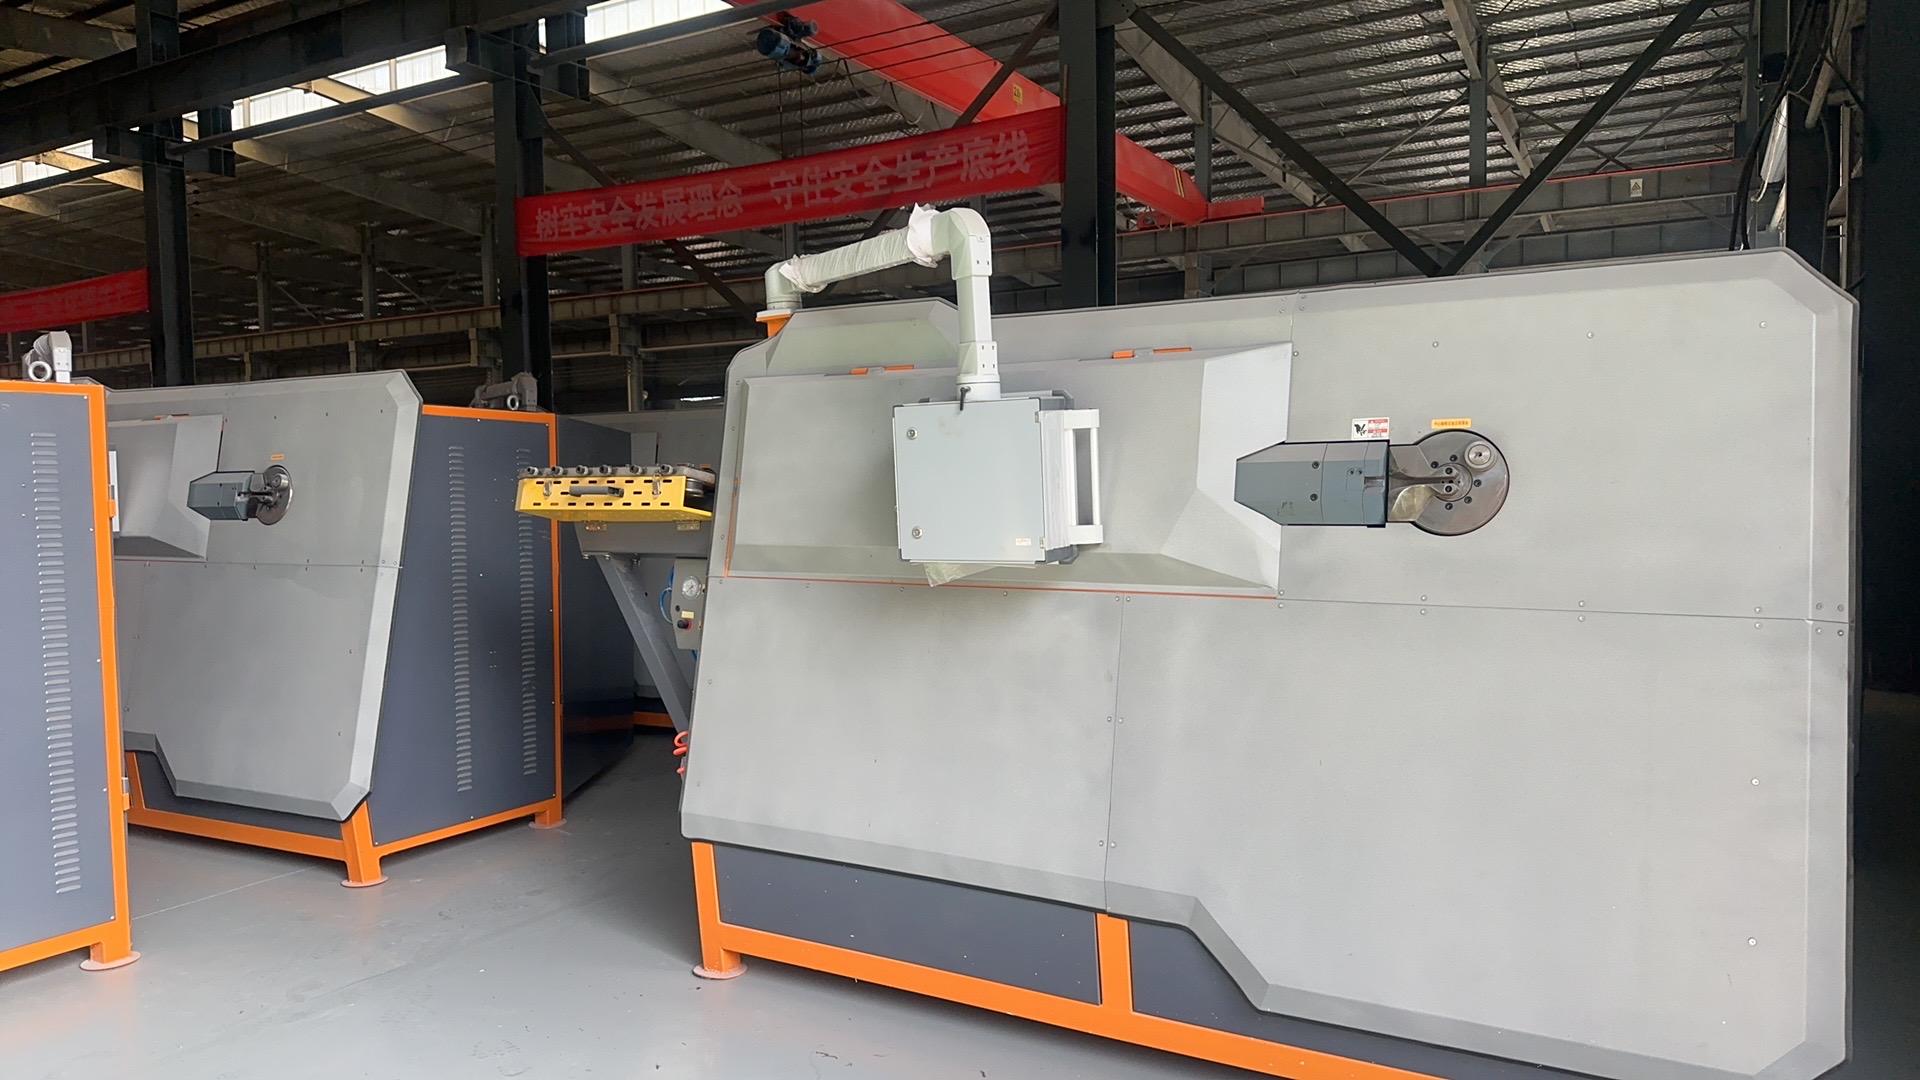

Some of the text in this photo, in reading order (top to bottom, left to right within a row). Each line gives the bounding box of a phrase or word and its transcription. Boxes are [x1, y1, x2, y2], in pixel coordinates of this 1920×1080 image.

[535, 130, 1031, 241] 树牢安全发展理念 守住安全生产底线
